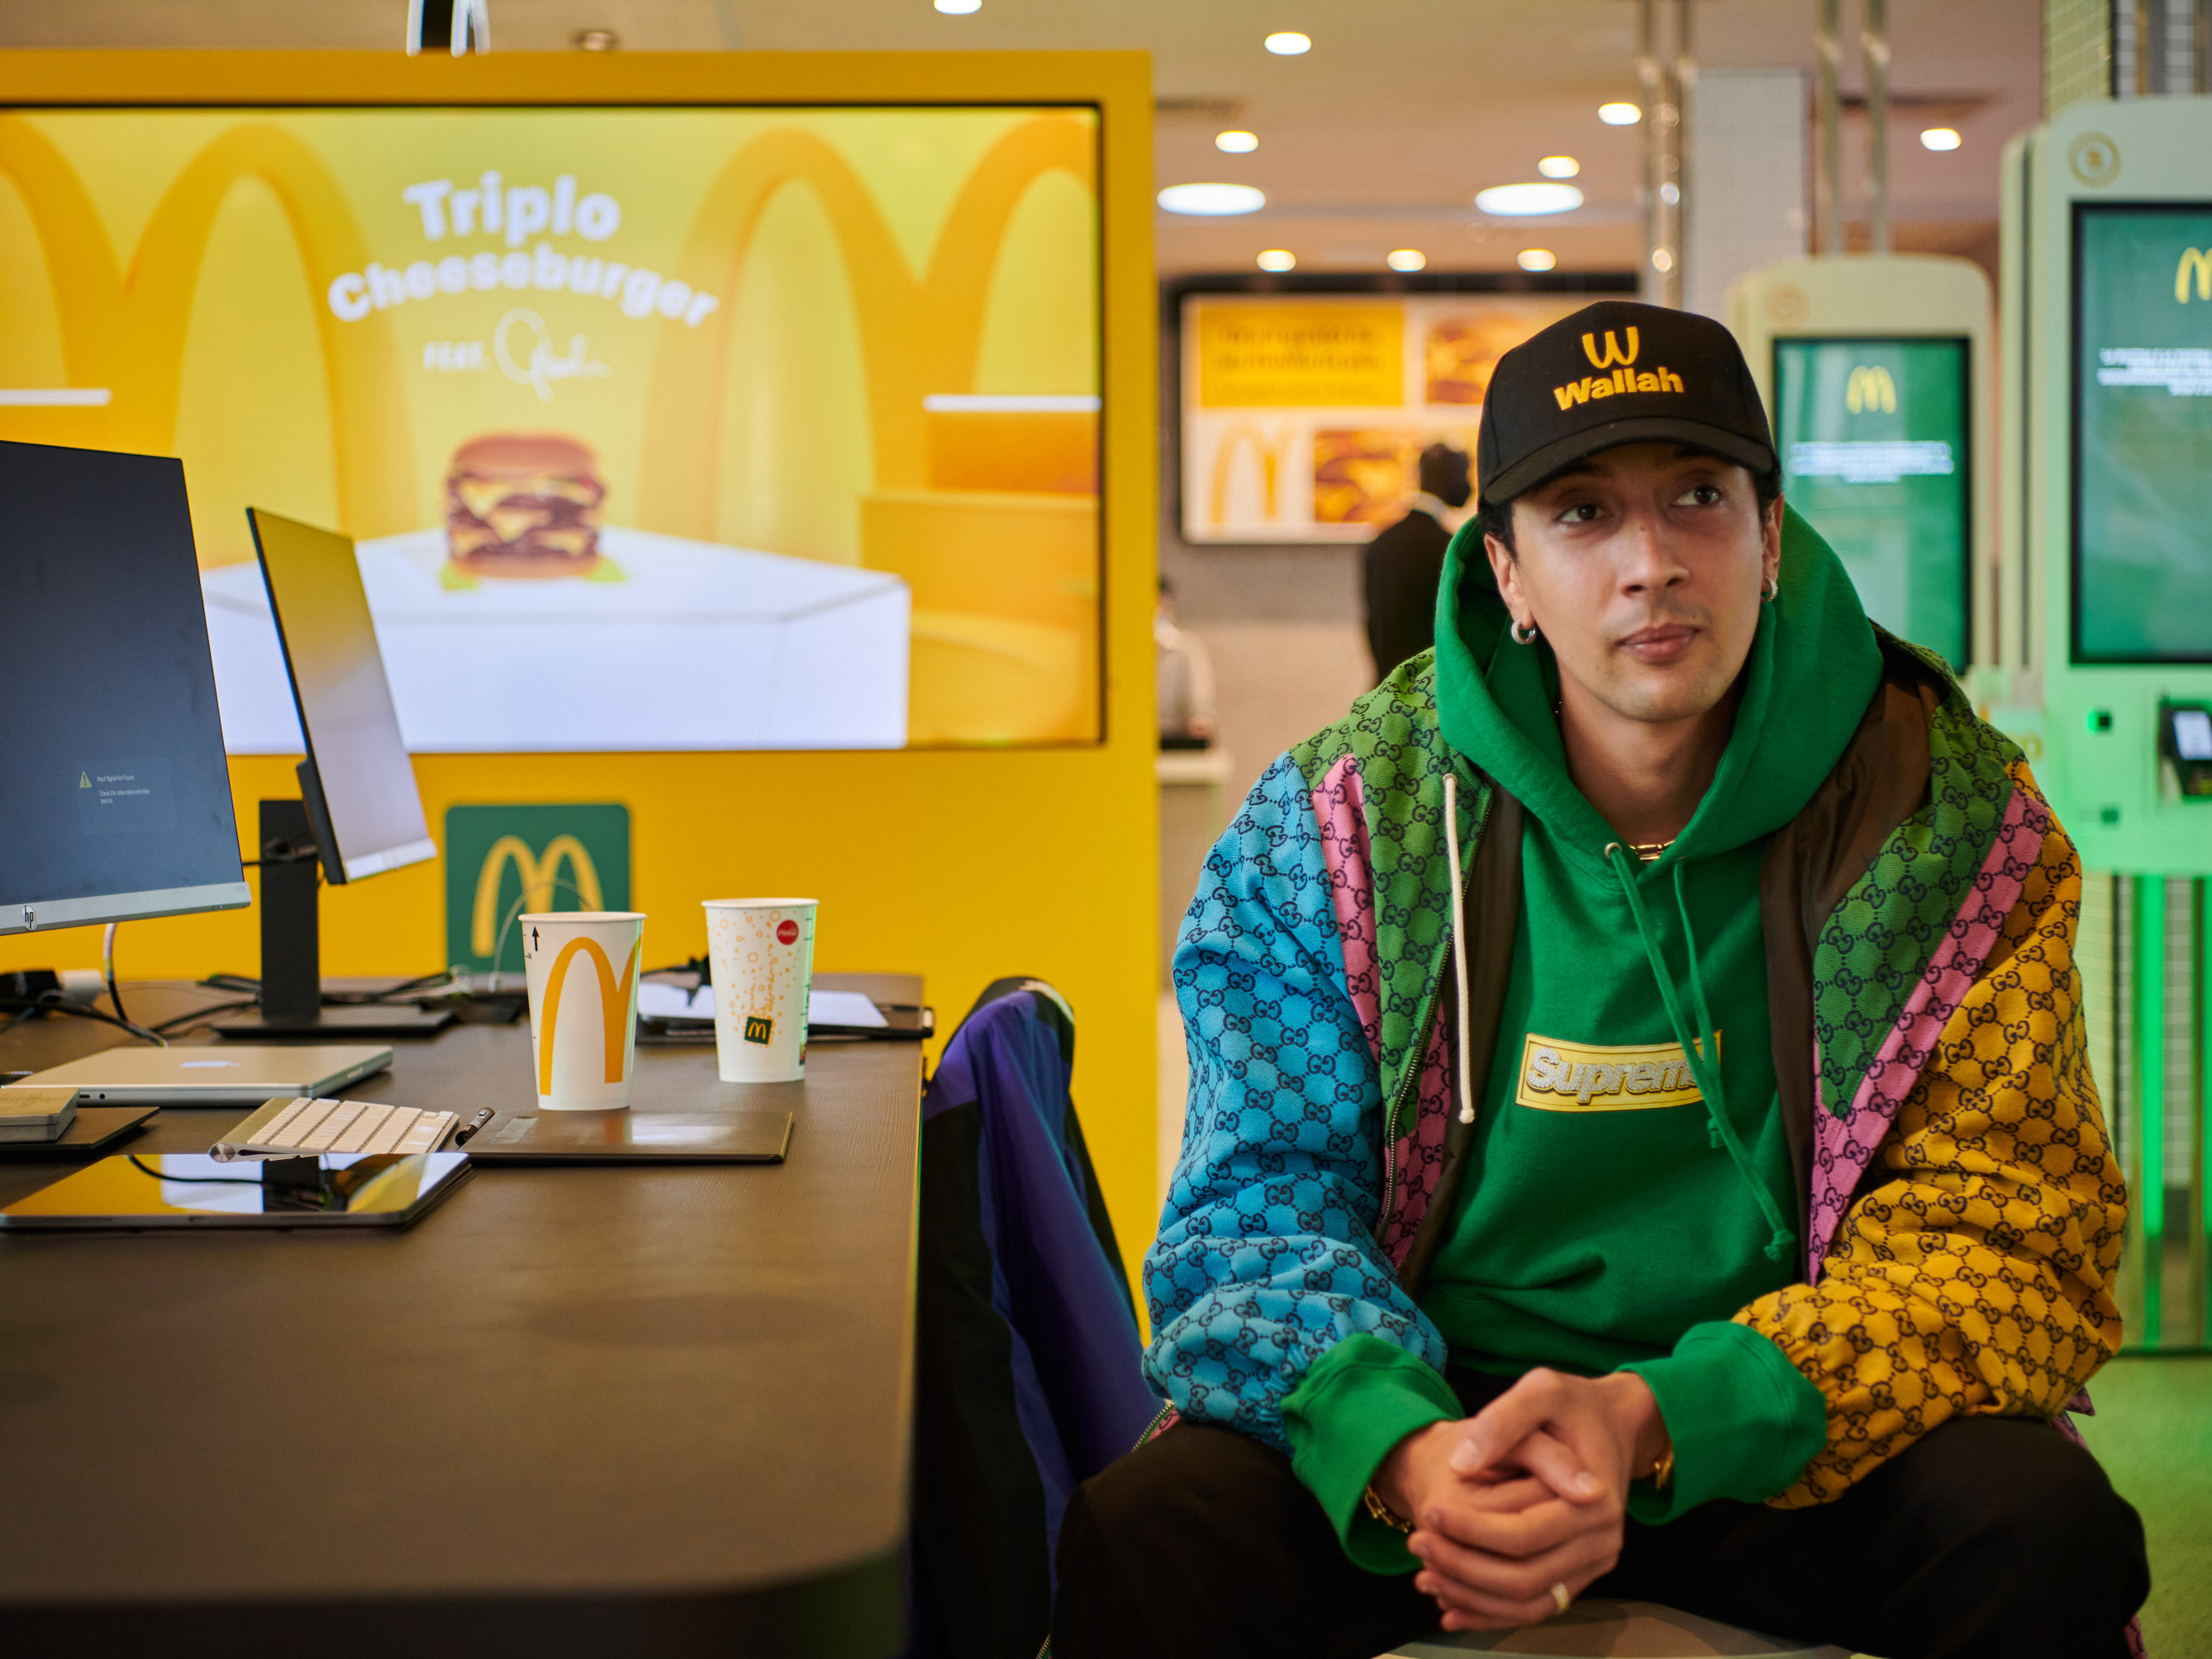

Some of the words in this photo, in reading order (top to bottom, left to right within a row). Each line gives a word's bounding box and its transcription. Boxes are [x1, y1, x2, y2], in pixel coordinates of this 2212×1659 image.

[402, 169, 623, 248] Triplo
[328, 242, 720, 328] Cheeseburger
[1553, 366, 1685, 411] Wallah
[24, 905, 35, 929] hp
[1526, 1047, 1705, 1105] Suprem
